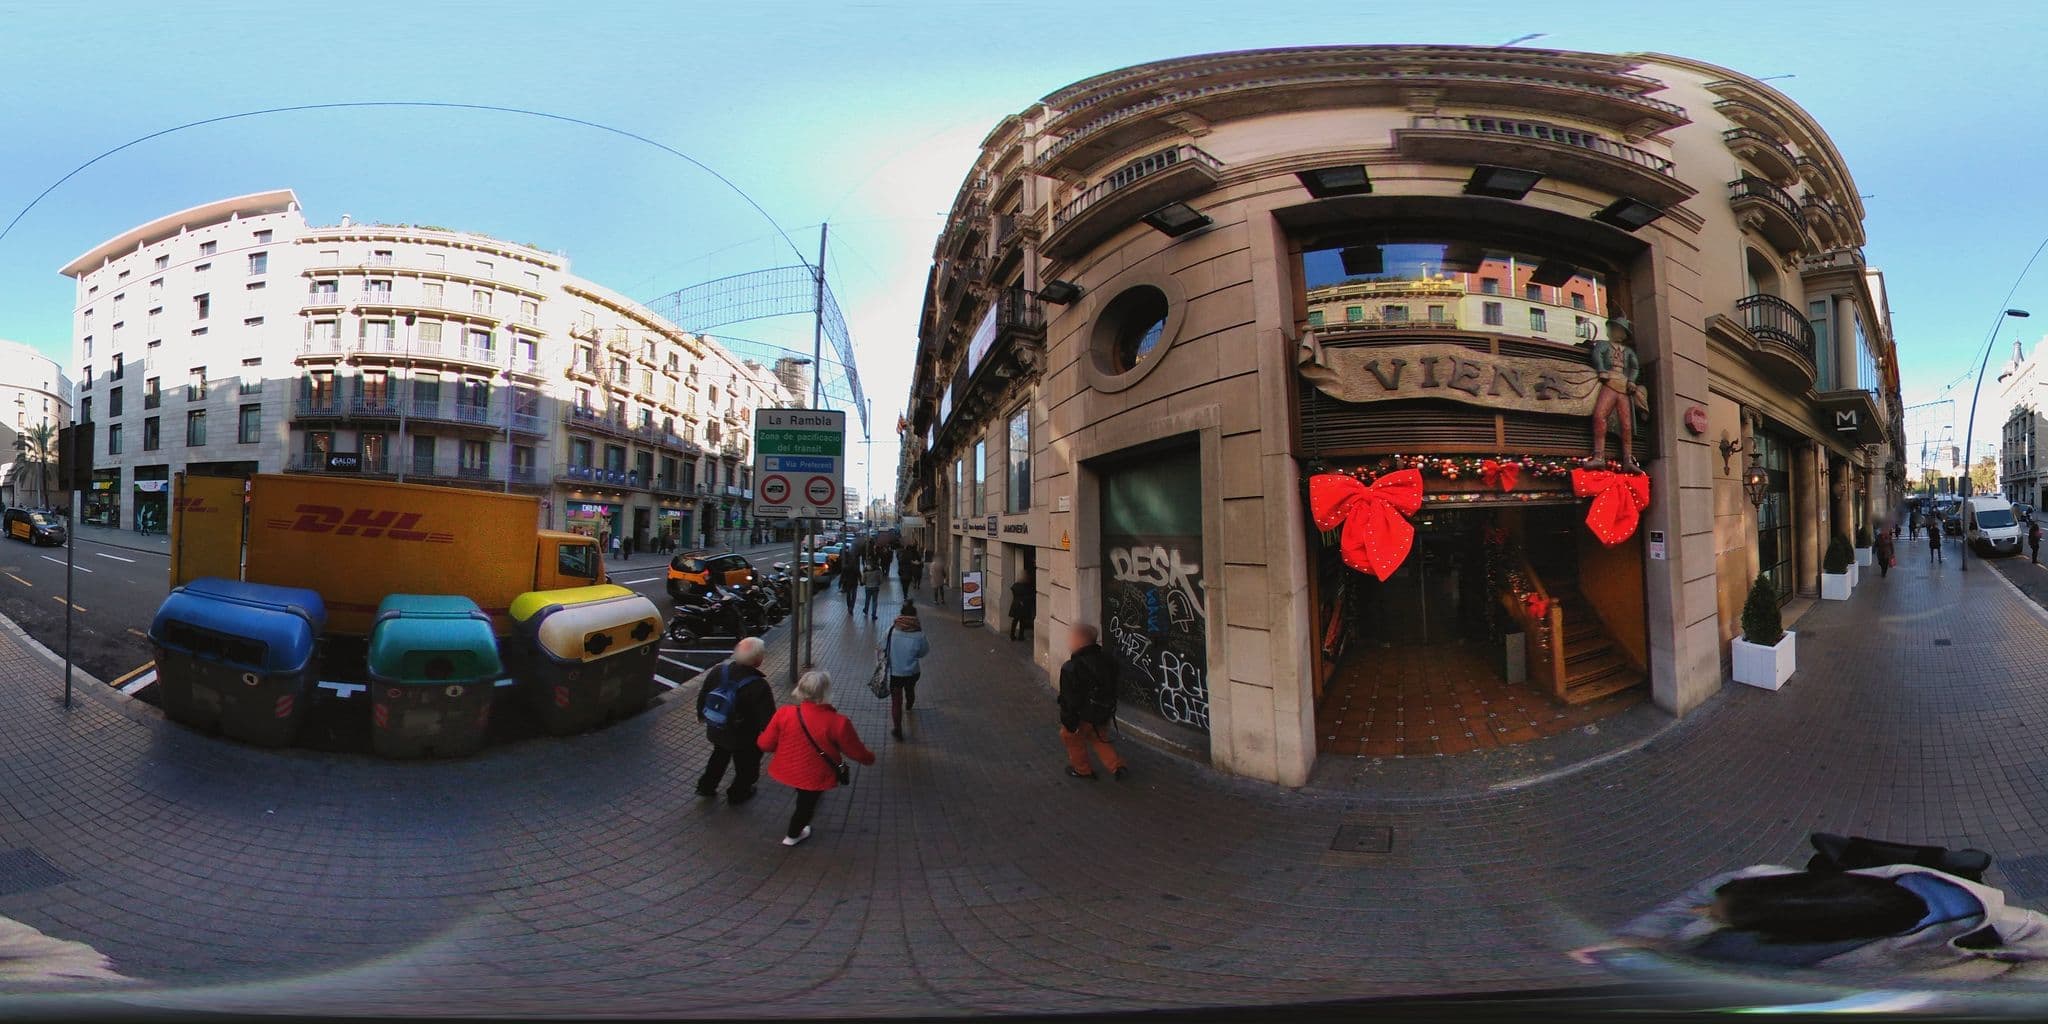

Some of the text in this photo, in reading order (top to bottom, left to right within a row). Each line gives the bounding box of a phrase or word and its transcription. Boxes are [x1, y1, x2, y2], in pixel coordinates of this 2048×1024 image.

[1364, 355, 1572, 400] VIENA
[769, 415, 832, 426] La Rambla
[760, 432, 779, 440] Zona
[777, 444, 790, 452] del
[289, 503, 429, 542] DHL
